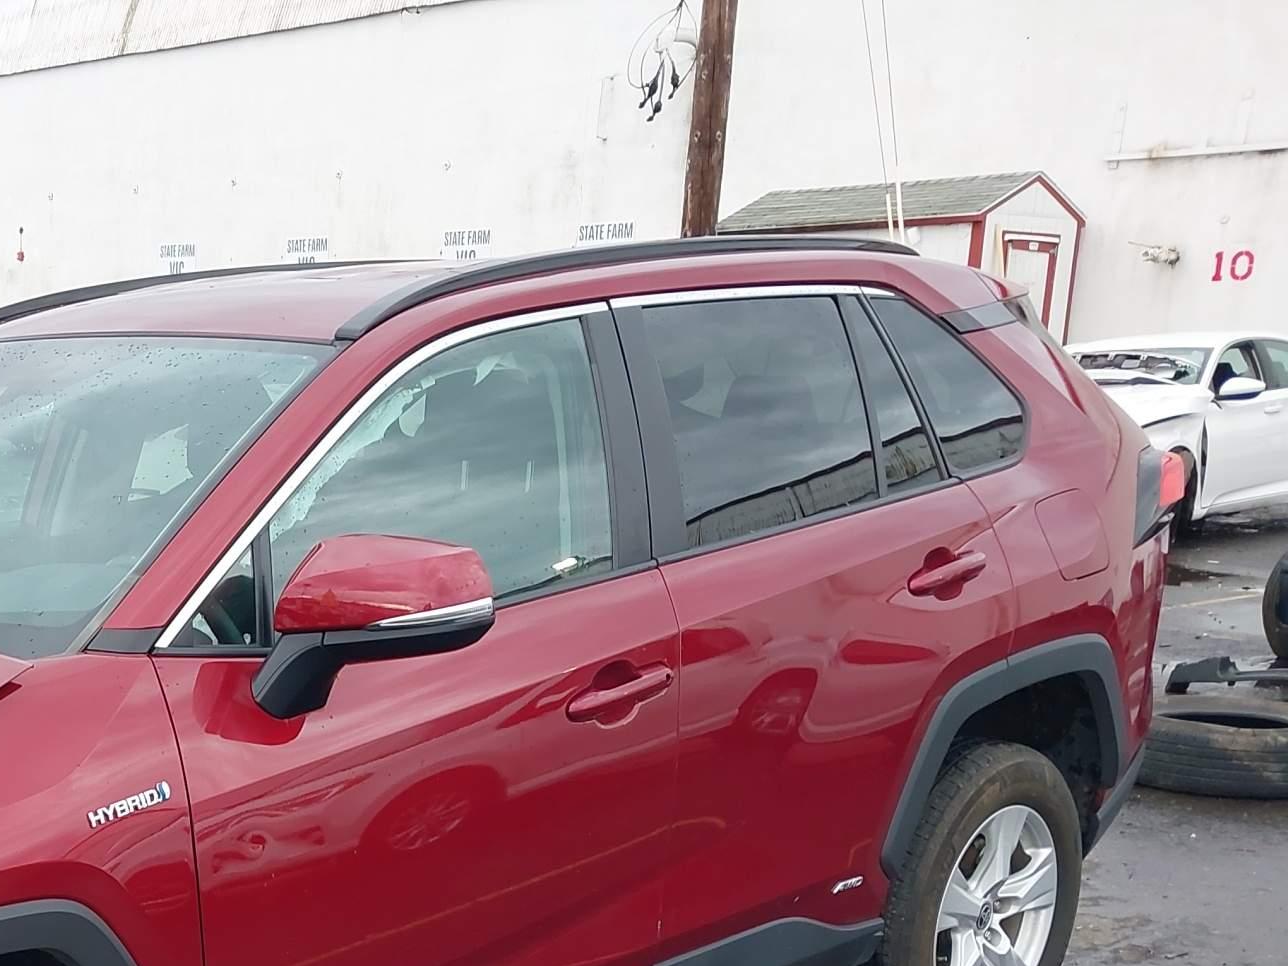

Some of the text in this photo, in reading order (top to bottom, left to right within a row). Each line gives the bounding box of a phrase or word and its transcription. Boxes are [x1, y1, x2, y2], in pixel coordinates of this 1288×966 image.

[444, 229, 490, 246] STATE FARM
[579, 222, 633, 241] STATE FARM
[160, 244, 195, 258] STATE FARM
[287, 237, 328, 253] STATE FARM
[1212, 250, 1254, 281] 10
[87, 788, 162, 828] HYBRID
